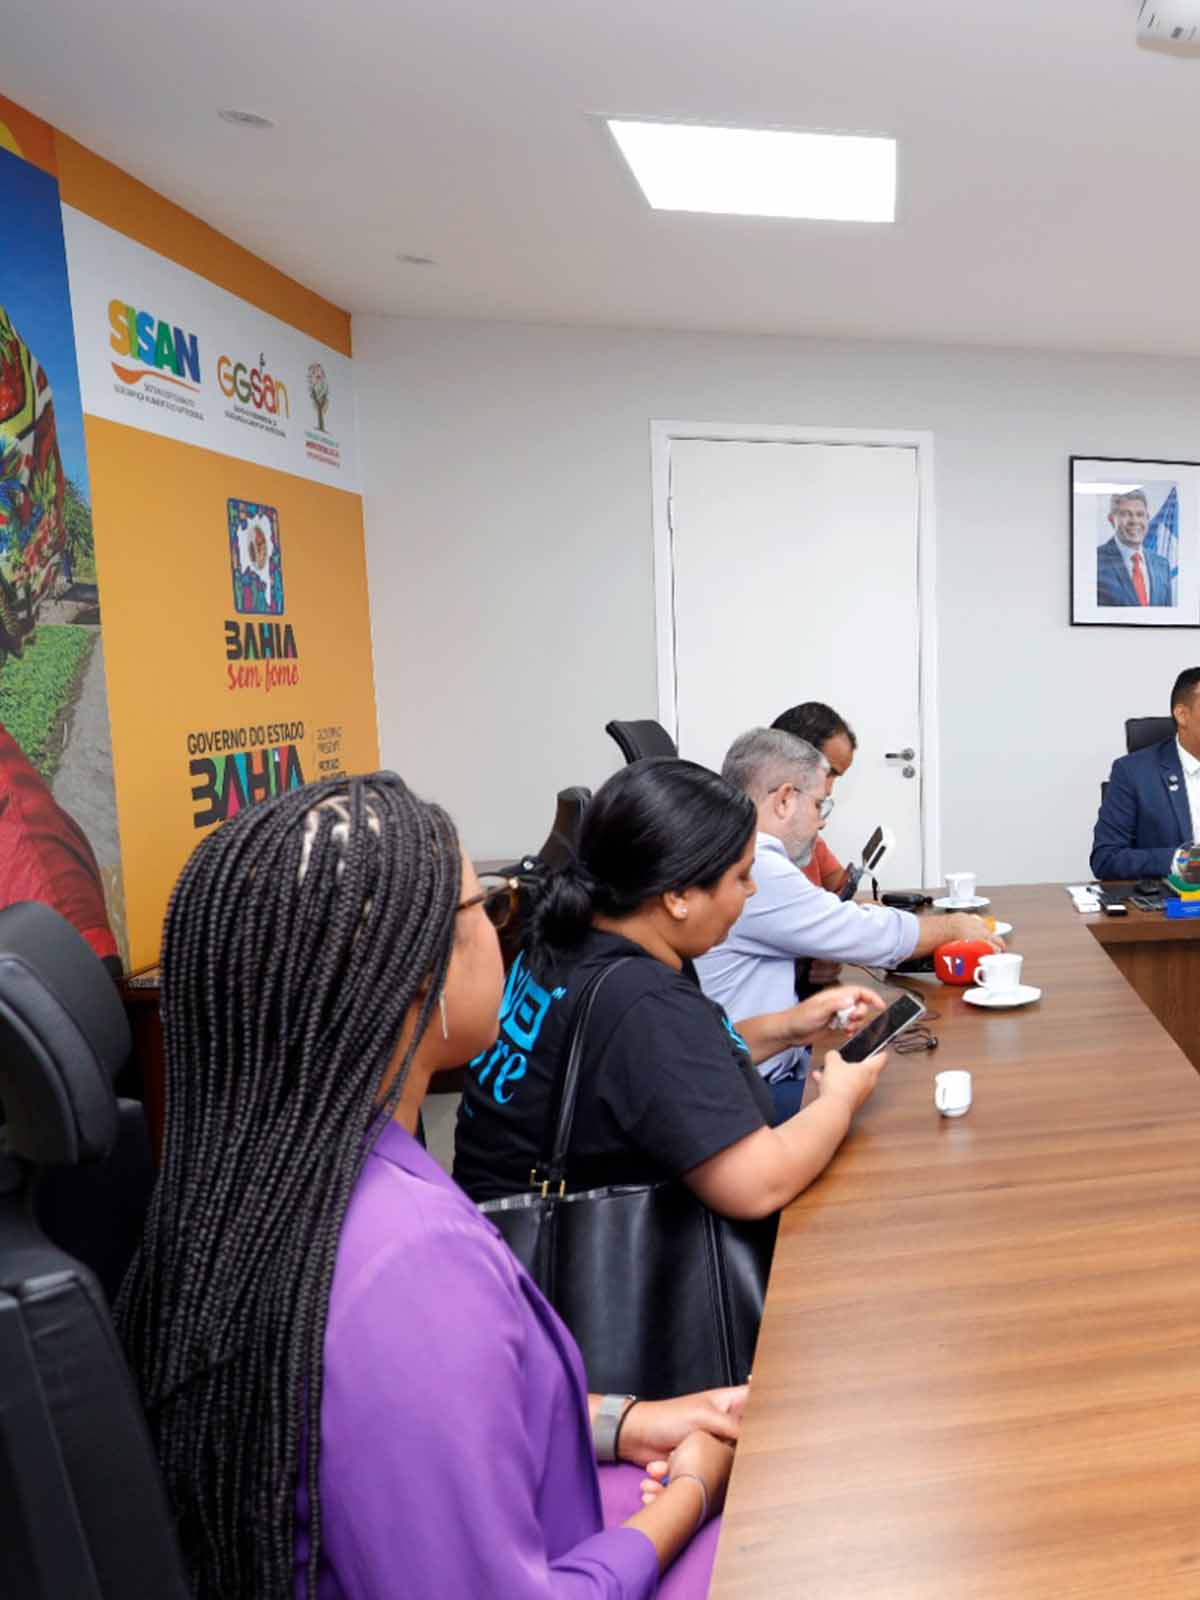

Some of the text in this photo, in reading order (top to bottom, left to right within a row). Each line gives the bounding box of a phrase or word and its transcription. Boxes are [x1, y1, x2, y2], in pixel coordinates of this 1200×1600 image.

[108, 299, 202, 385] SISAN
[224, 620, 298, 660] BAHIA
[226, 659, 300, 693] sem fome
[187, 728, 248, 755] GOVERNO
[249, 726, 266, 747] DO
[267, 721, 305, 744] ESTADO
[189, 744, 305, 829] BAHIA
